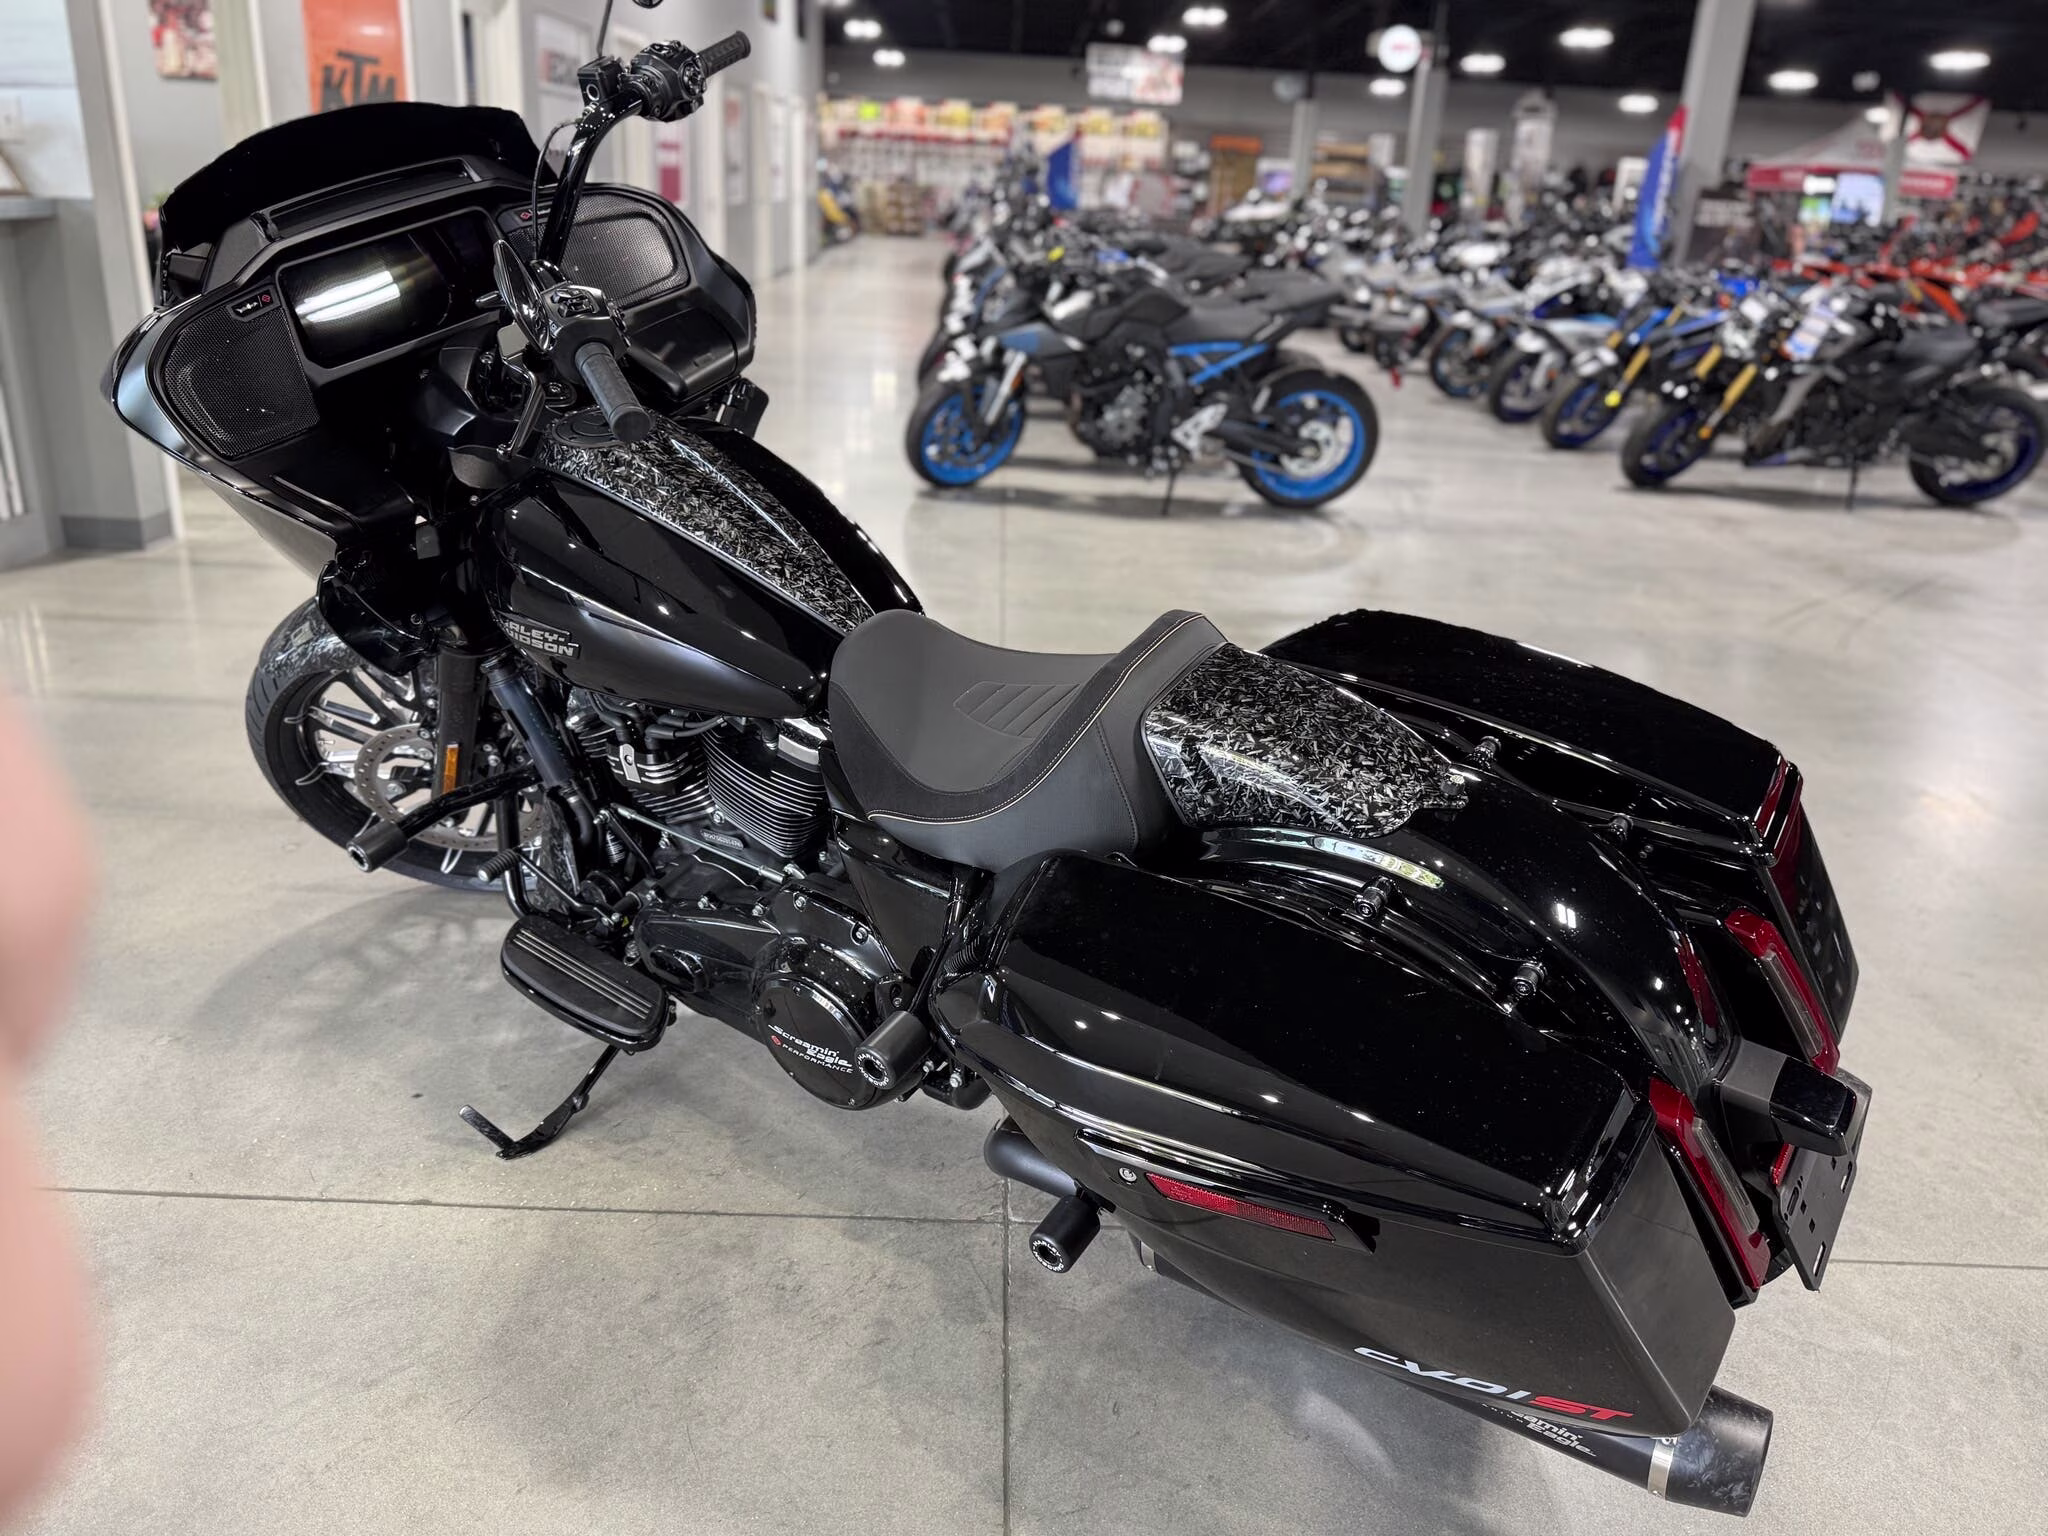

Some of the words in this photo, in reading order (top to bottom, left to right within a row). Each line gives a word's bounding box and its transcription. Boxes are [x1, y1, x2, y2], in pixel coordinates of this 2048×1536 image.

[322, 49, 396, 112] KTM
[782, 1043, 854, 1074] PERFORMANCE
[806, 1047, 853, 1068] Eagle
[1526, 1422, 1597, 1457] Eagle
